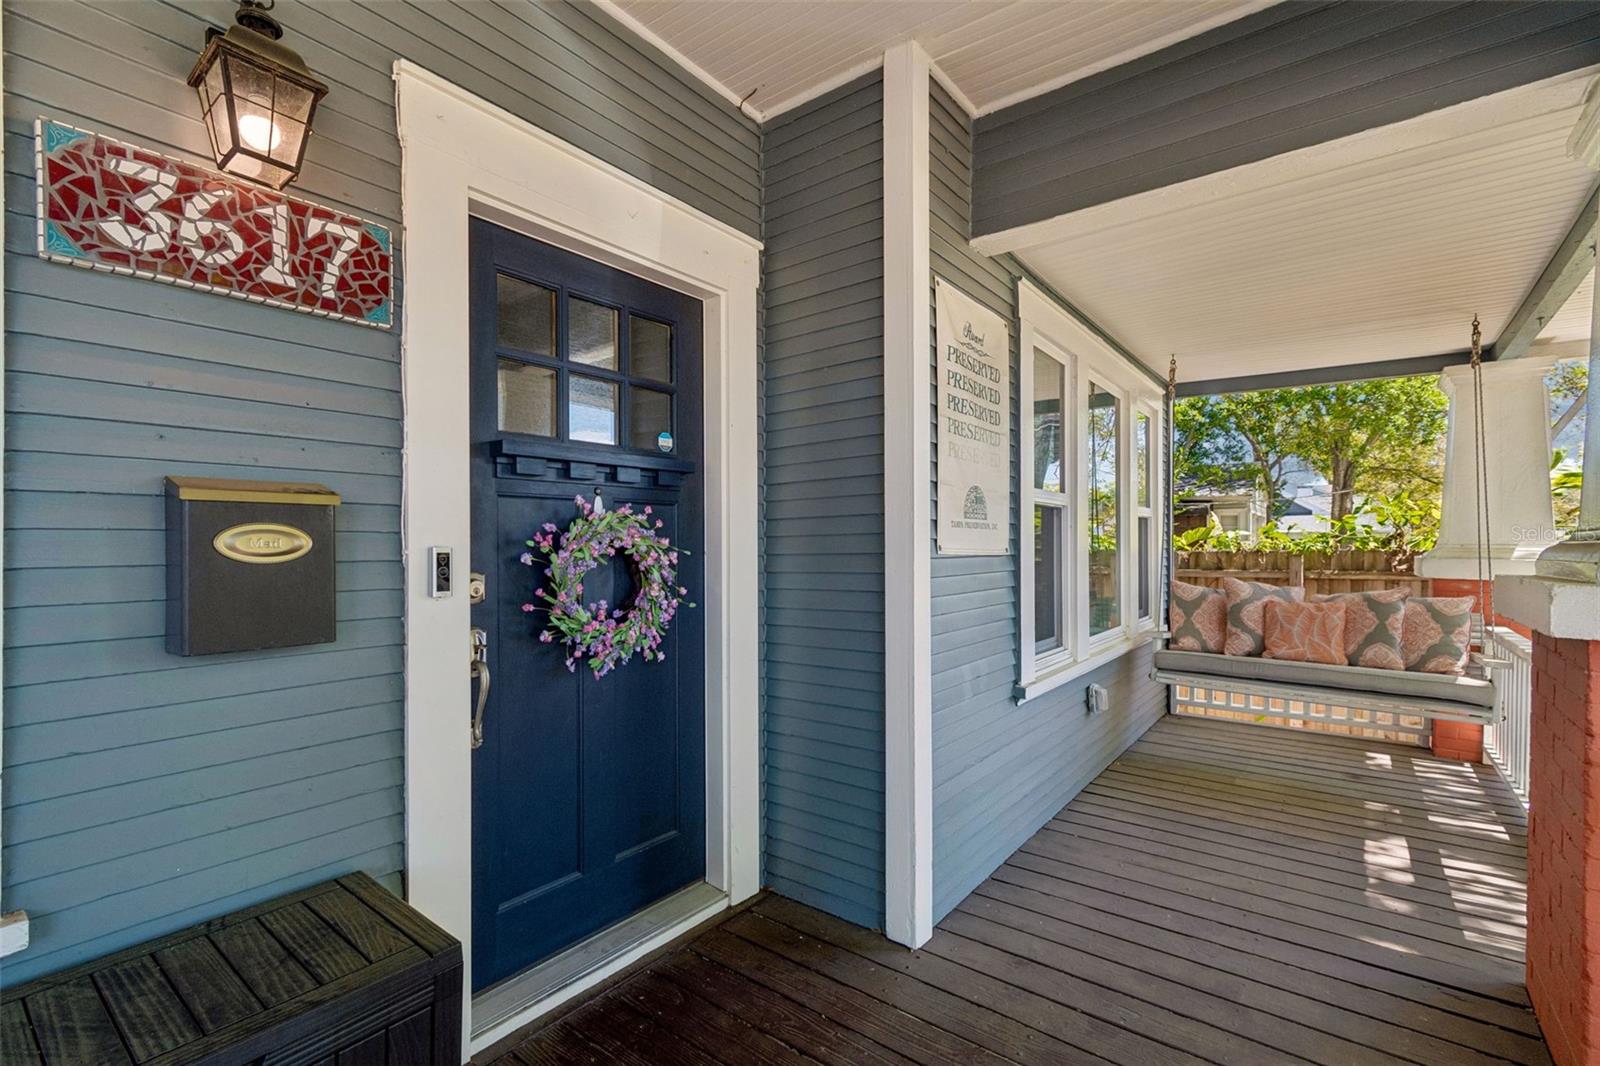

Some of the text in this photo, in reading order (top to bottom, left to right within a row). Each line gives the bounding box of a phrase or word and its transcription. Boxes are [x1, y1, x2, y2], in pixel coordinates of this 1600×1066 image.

[99, 156, 359, 299] 3617
[946, 344, 1000, 384] PRESERVED
[946, 368, 1000, 405] PRESERVED
[946, 392, 1000, 426] PRESERVED
[947, 417, 1000, 447] PRESERVED
